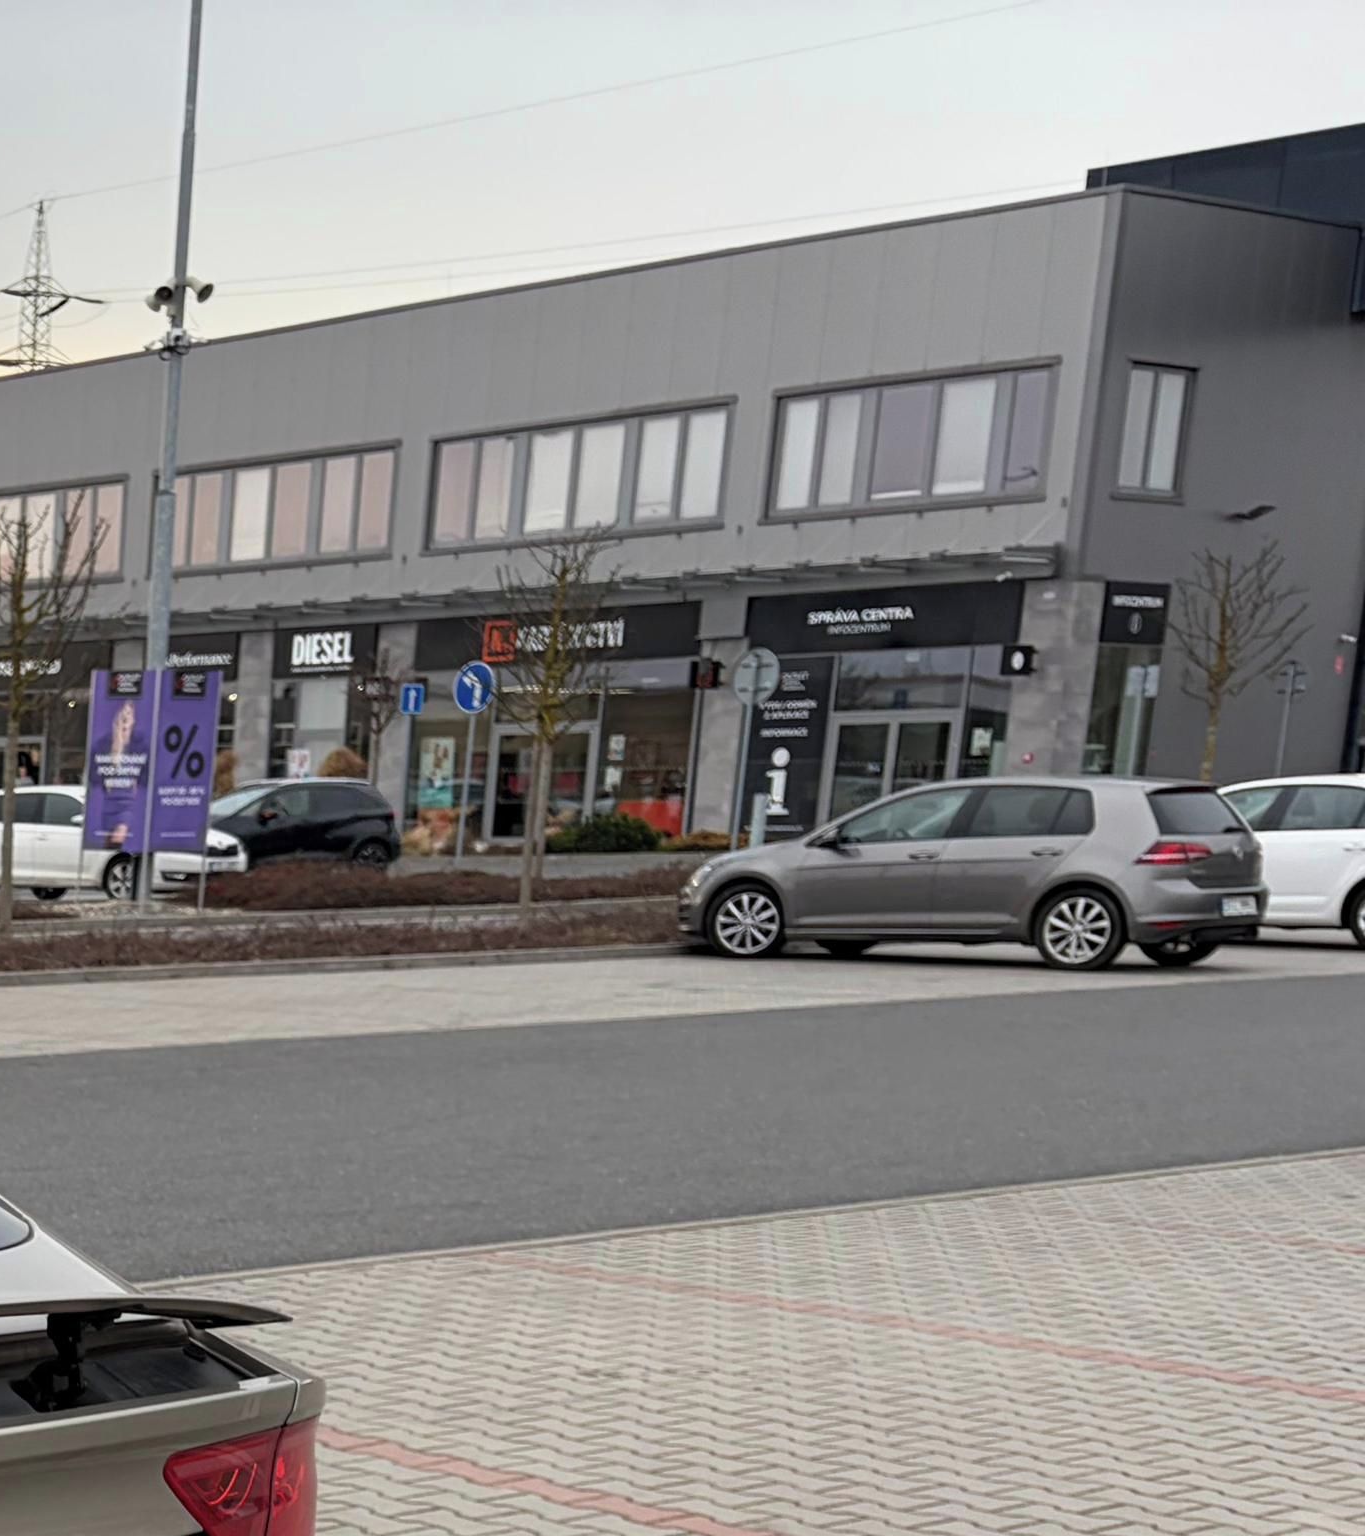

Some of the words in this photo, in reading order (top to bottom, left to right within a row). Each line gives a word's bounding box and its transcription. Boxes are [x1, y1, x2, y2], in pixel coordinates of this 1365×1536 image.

[861, 606, 915, 622] CENTRA
[291, 630, 355, 666] DIESEL
[165, 650, 233, 668] Performance
